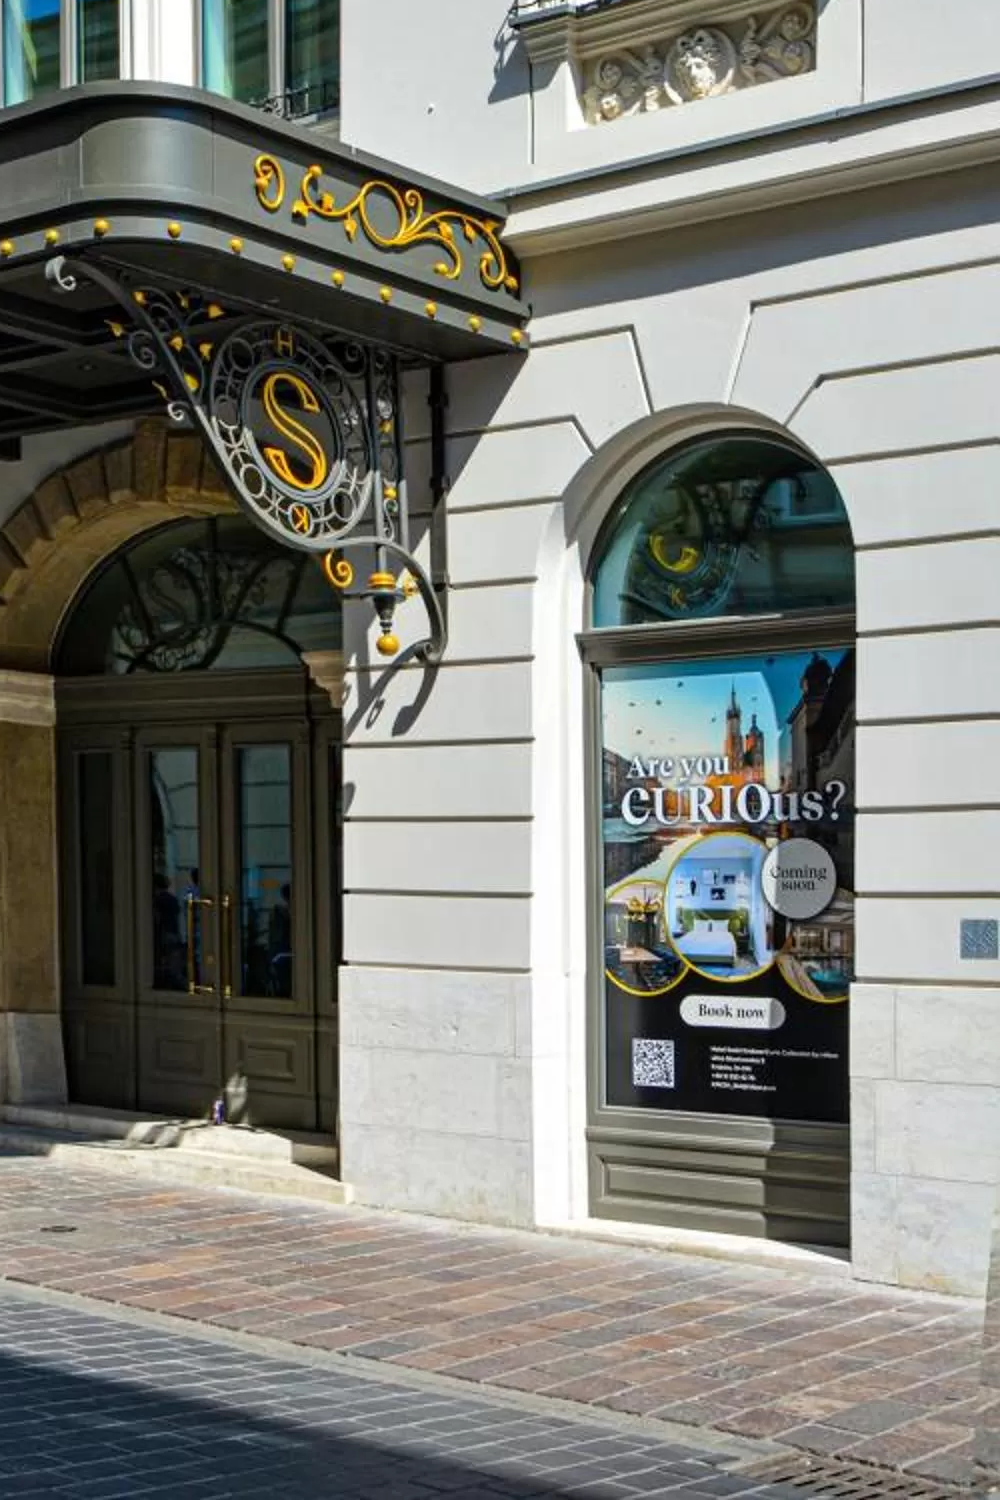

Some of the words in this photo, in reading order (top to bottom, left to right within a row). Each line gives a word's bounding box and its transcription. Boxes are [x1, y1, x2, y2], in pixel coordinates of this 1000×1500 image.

[625, 756, 674, 780] Are
[679, 755, 731, 784] you
[770, 864, 827, 880] Coming
[781, 880, 816, 892] soon
[698, 1002, 733, 1019] Book
[736, 1007, 766, 1020] now
